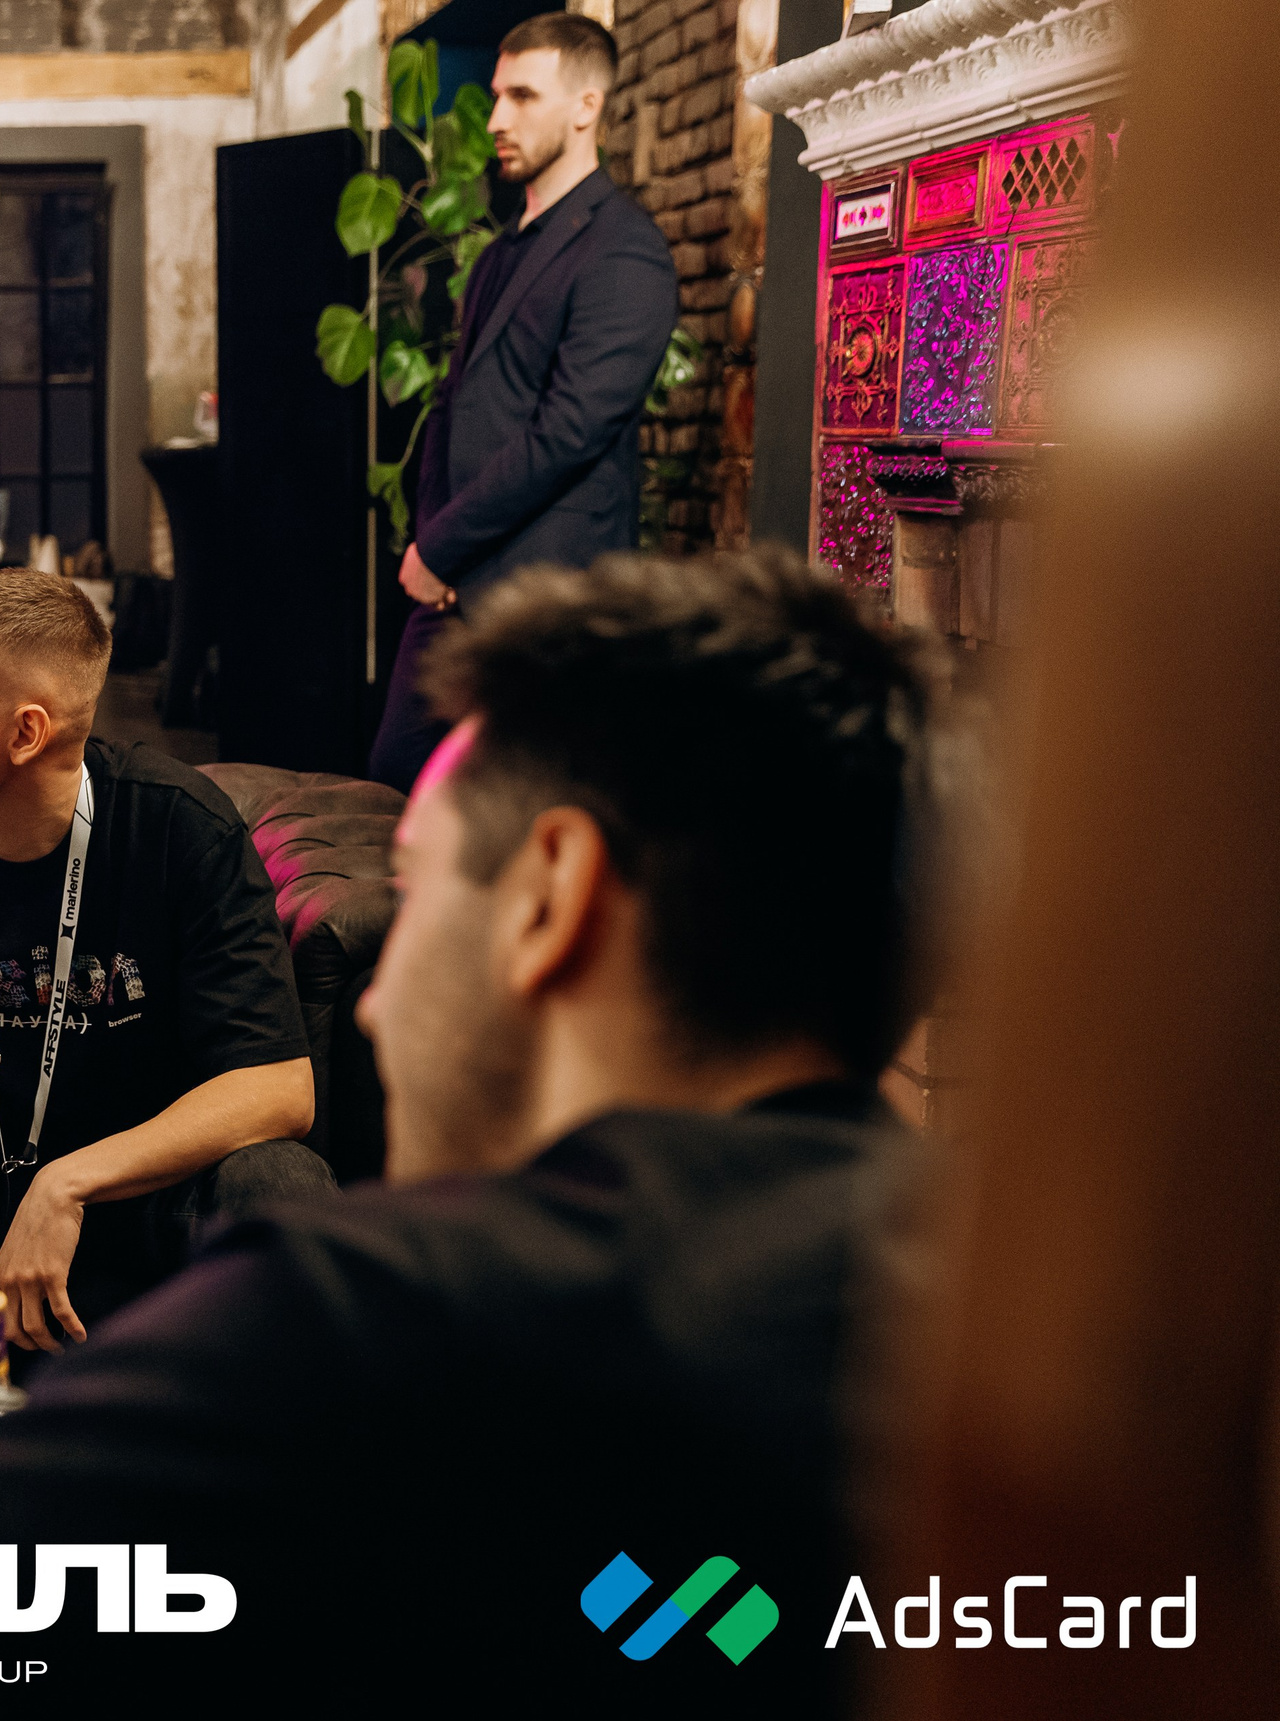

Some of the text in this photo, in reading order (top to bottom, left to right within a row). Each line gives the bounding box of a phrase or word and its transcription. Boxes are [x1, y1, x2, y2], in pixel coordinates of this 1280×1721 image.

[66, 858, 81, 920] marlerino
[43, 978, 66, 1078] AFFSTYLE
[108, 1012, 142, 1028] browser
